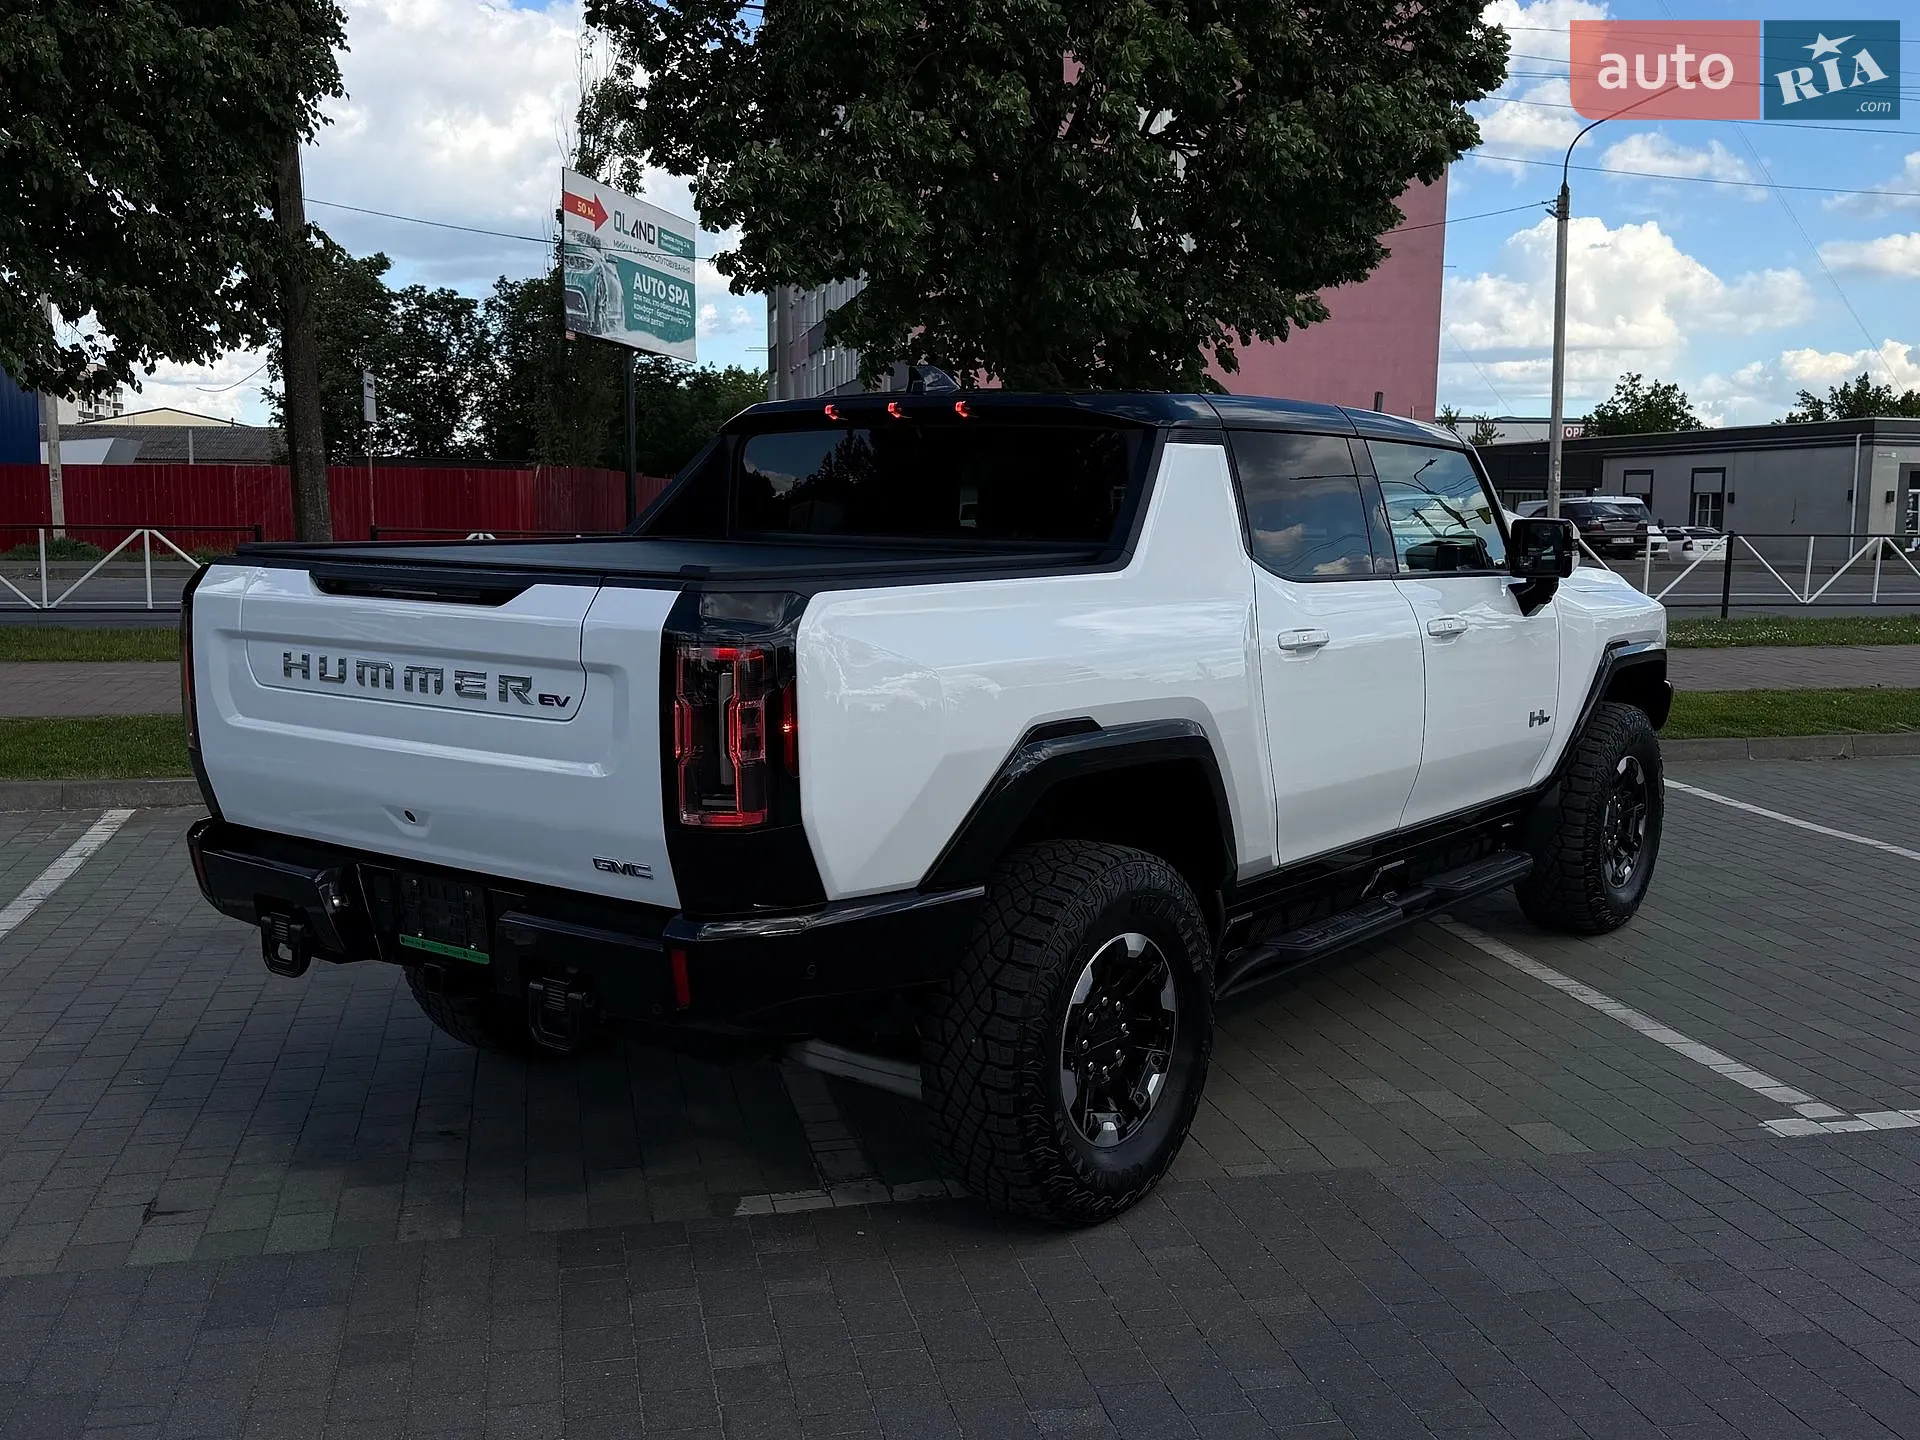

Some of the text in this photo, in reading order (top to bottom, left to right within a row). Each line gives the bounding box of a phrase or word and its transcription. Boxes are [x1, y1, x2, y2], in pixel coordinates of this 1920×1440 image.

[577, 201, 587, 215] 50
[614, 209, 656, 245] OLAND
[633, 271, 691, 309] AUTO SPA
[282, 650, 571, 708] HUMMER EV
[592, 856, 654, 880] GMC
